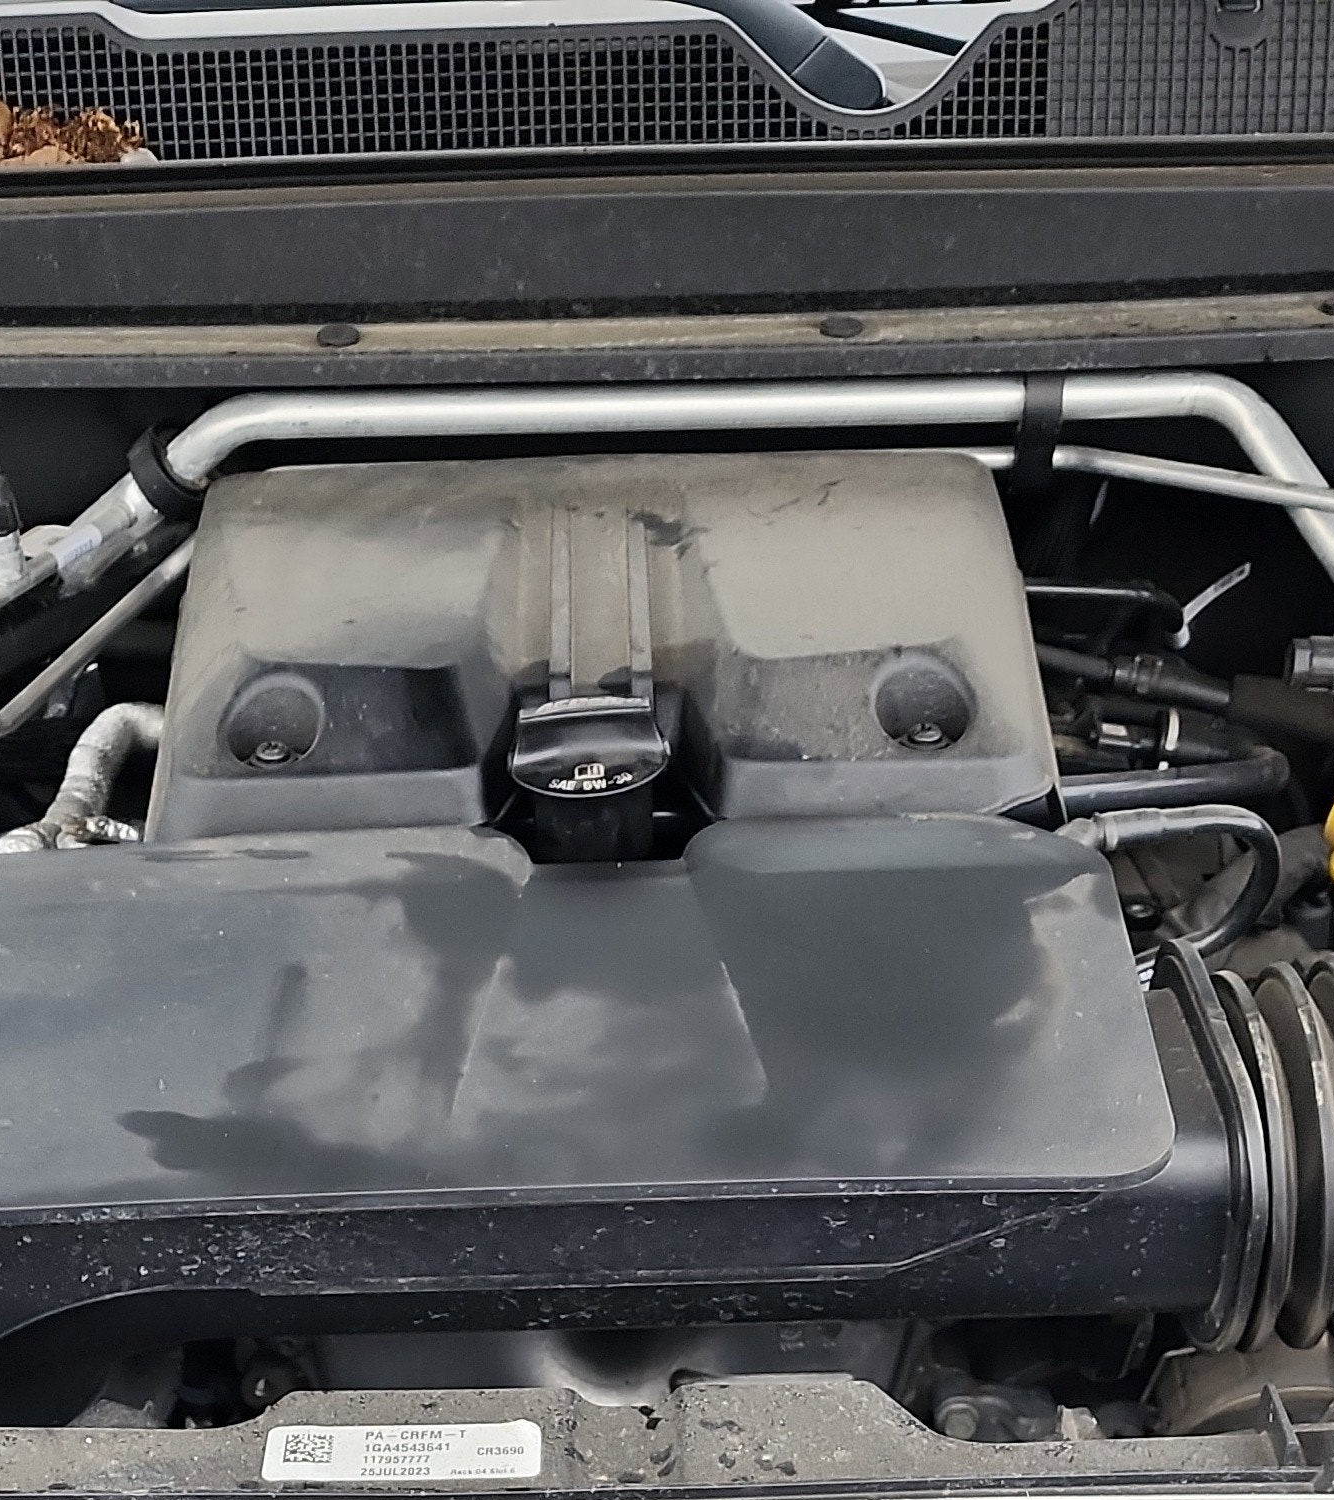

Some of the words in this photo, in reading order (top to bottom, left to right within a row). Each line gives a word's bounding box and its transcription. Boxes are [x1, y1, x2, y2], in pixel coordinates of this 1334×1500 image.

[548, 778, 577, 791] SAE
[365, 1442, 450, 1452] 1GA4543641
[477, 1446, 524, 1455] CR3690
[364, 1455, 430, 1464] 117957777
[360, 1467, 430, 1476] 25JUL2023
